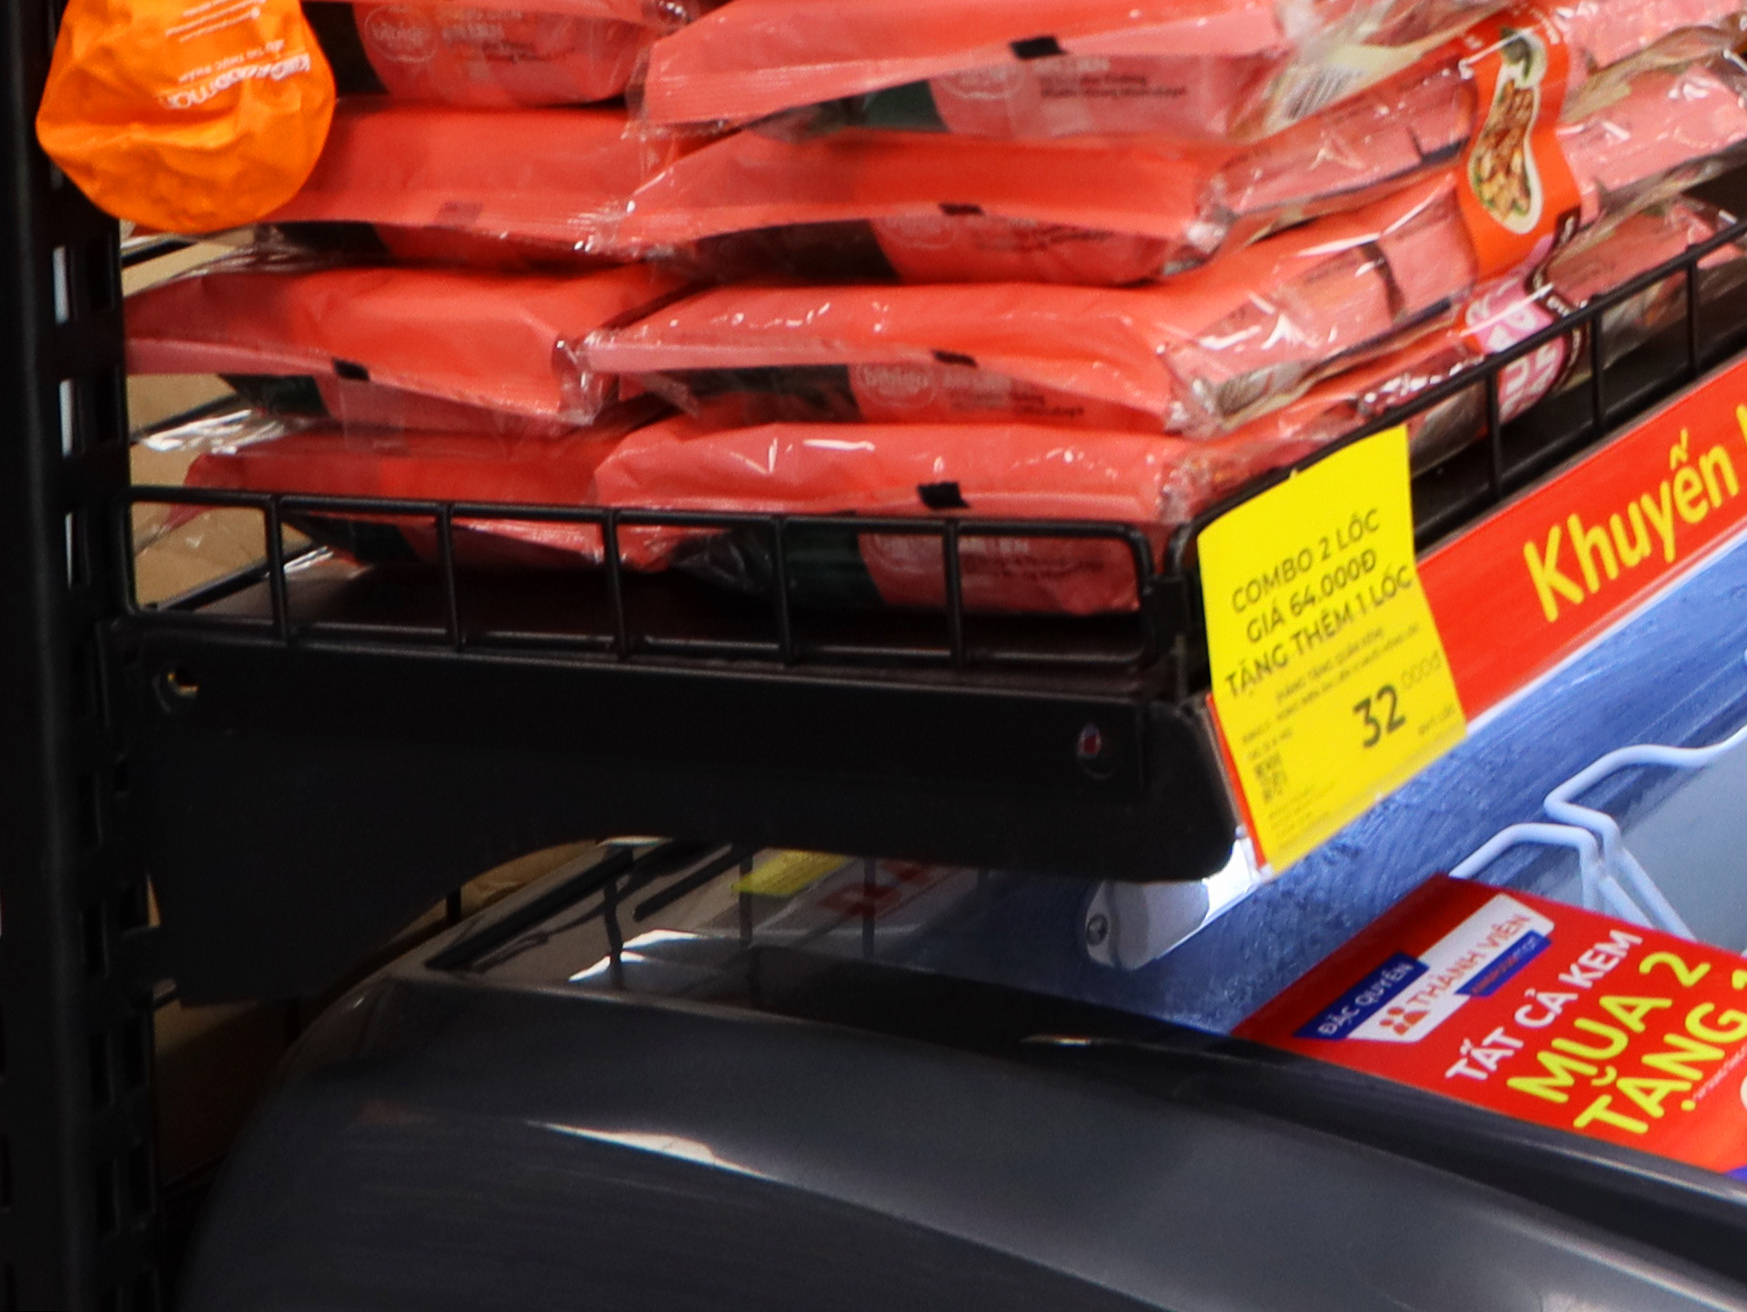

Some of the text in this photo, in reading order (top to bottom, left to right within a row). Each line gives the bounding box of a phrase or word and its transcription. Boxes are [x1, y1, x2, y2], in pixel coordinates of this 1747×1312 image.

[1231, 506, 1381, 614] COMBO 2 LỐC
[1523, 425, 1740, 623] Khuyến
[1225, 643, 1289, 699] TẶNG
[1290, 599, 1352, 656] THÊM
[1368, 563, 1414, 608] LỐC
[1246, 547, 1378, 644] GIÁ 64.000Đ
[1352, 683, 1407, 750] 32
[1444, 929, 1644, 1086] TẤT CẢ KEM
[1506, 951, 1712, 1104] MUA 2
